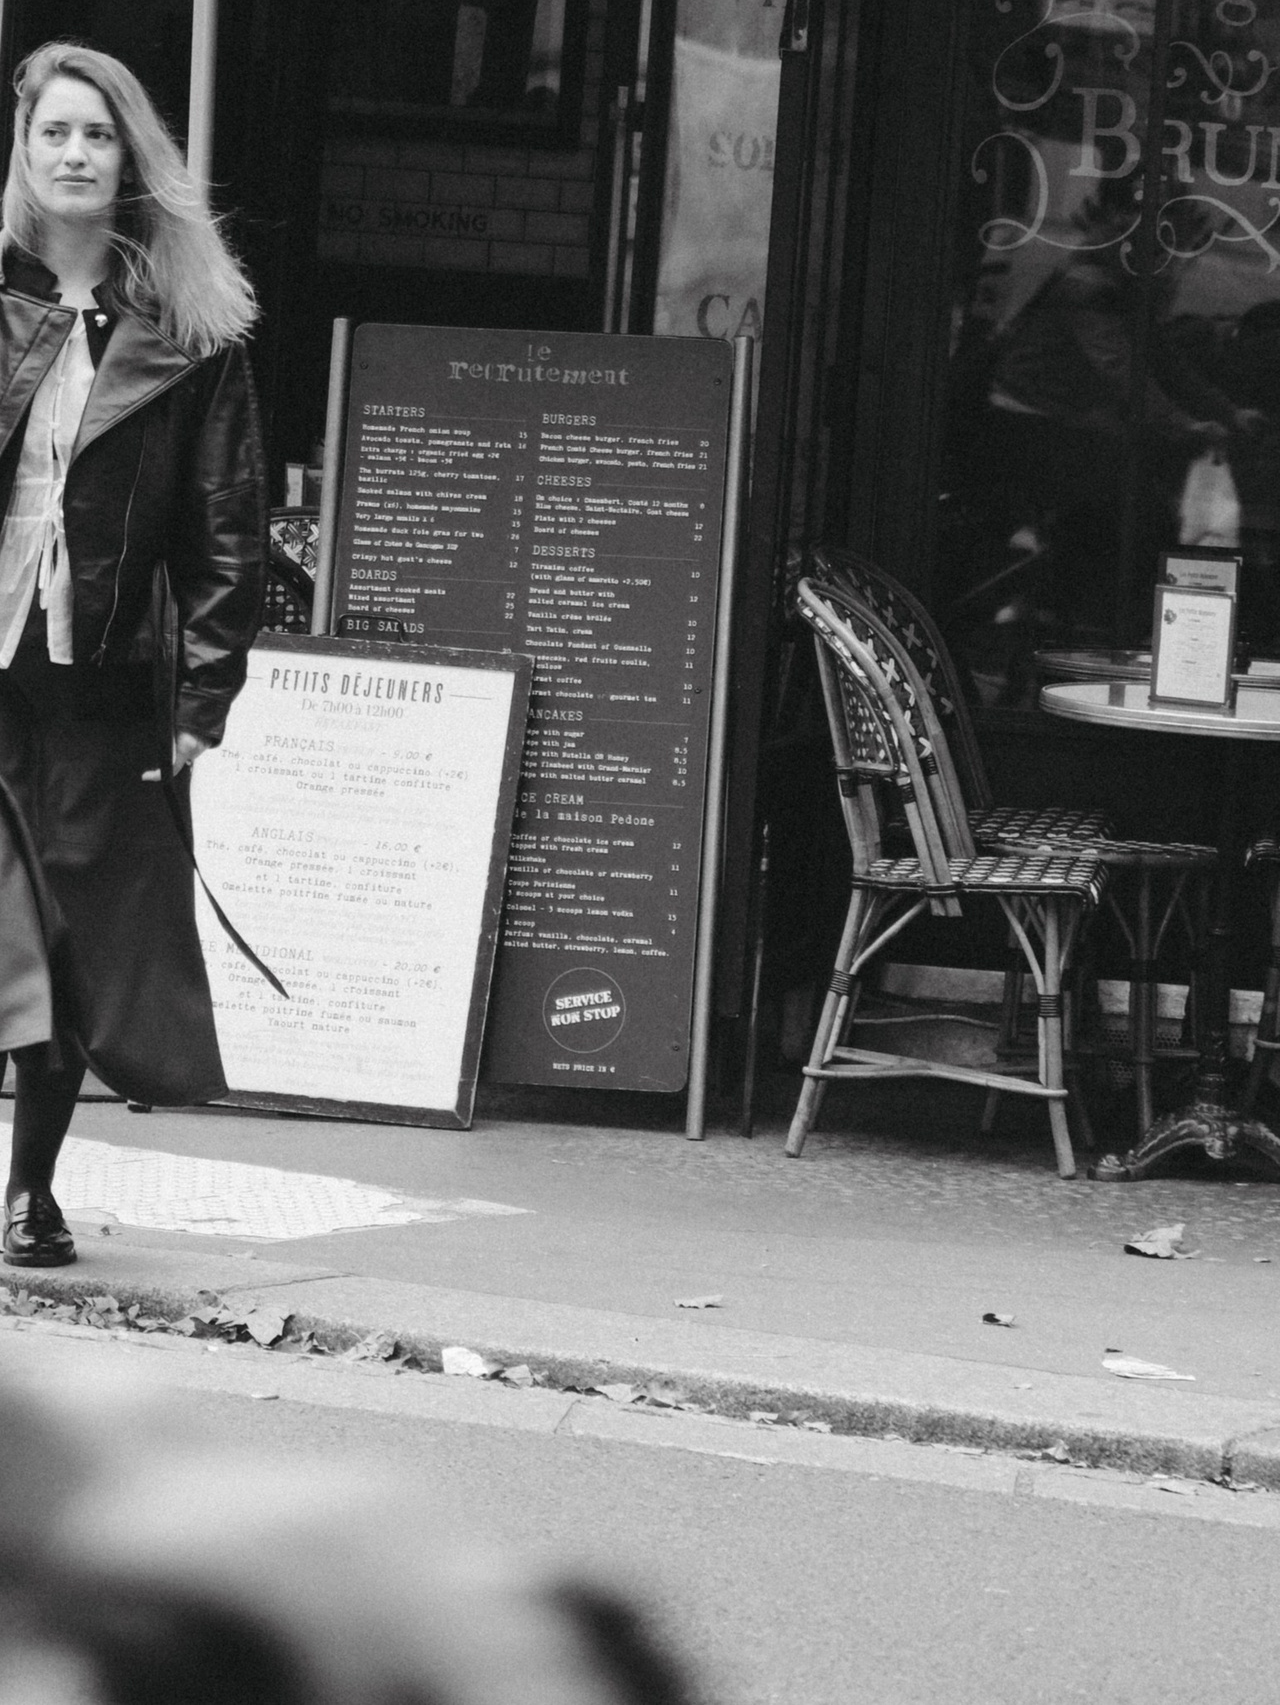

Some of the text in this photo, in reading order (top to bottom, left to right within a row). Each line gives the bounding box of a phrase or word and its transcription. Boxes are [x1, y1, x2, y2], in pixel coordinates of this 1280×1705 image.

[327, 204, 488, 233] NO SMOKING
[527, 344, 551, 361] le
[448, 361, 629, 384] recrutement
[363, 404, 424, 416] STARTERS
[542, 413, 595, 425] BURGERS
[537, 475, 591, 486] CHEESES
[532, 545, 594, 557] DESSERTS
[350, 568, 396, 580] BOARDS
[346, 619, 424, 633] BIG SALADS
[270, 668, 329, 693] PETITS
[530, 709, 582, 720] ANCAKES
[264, 735, 334, 752] FRANÇAIS
[522, 792, 583, 804] CE CREAM
[251, 827, 313, 843] ANGLAIS
[279, 889, 329, 899] poitrine
[213, 999, 255, 1012] melette
[262, 1006, 312, 1017] poitrine
[554, 990, 613, 1012] SERVICE
[550, 1003, 621, 1027] NON STOP
